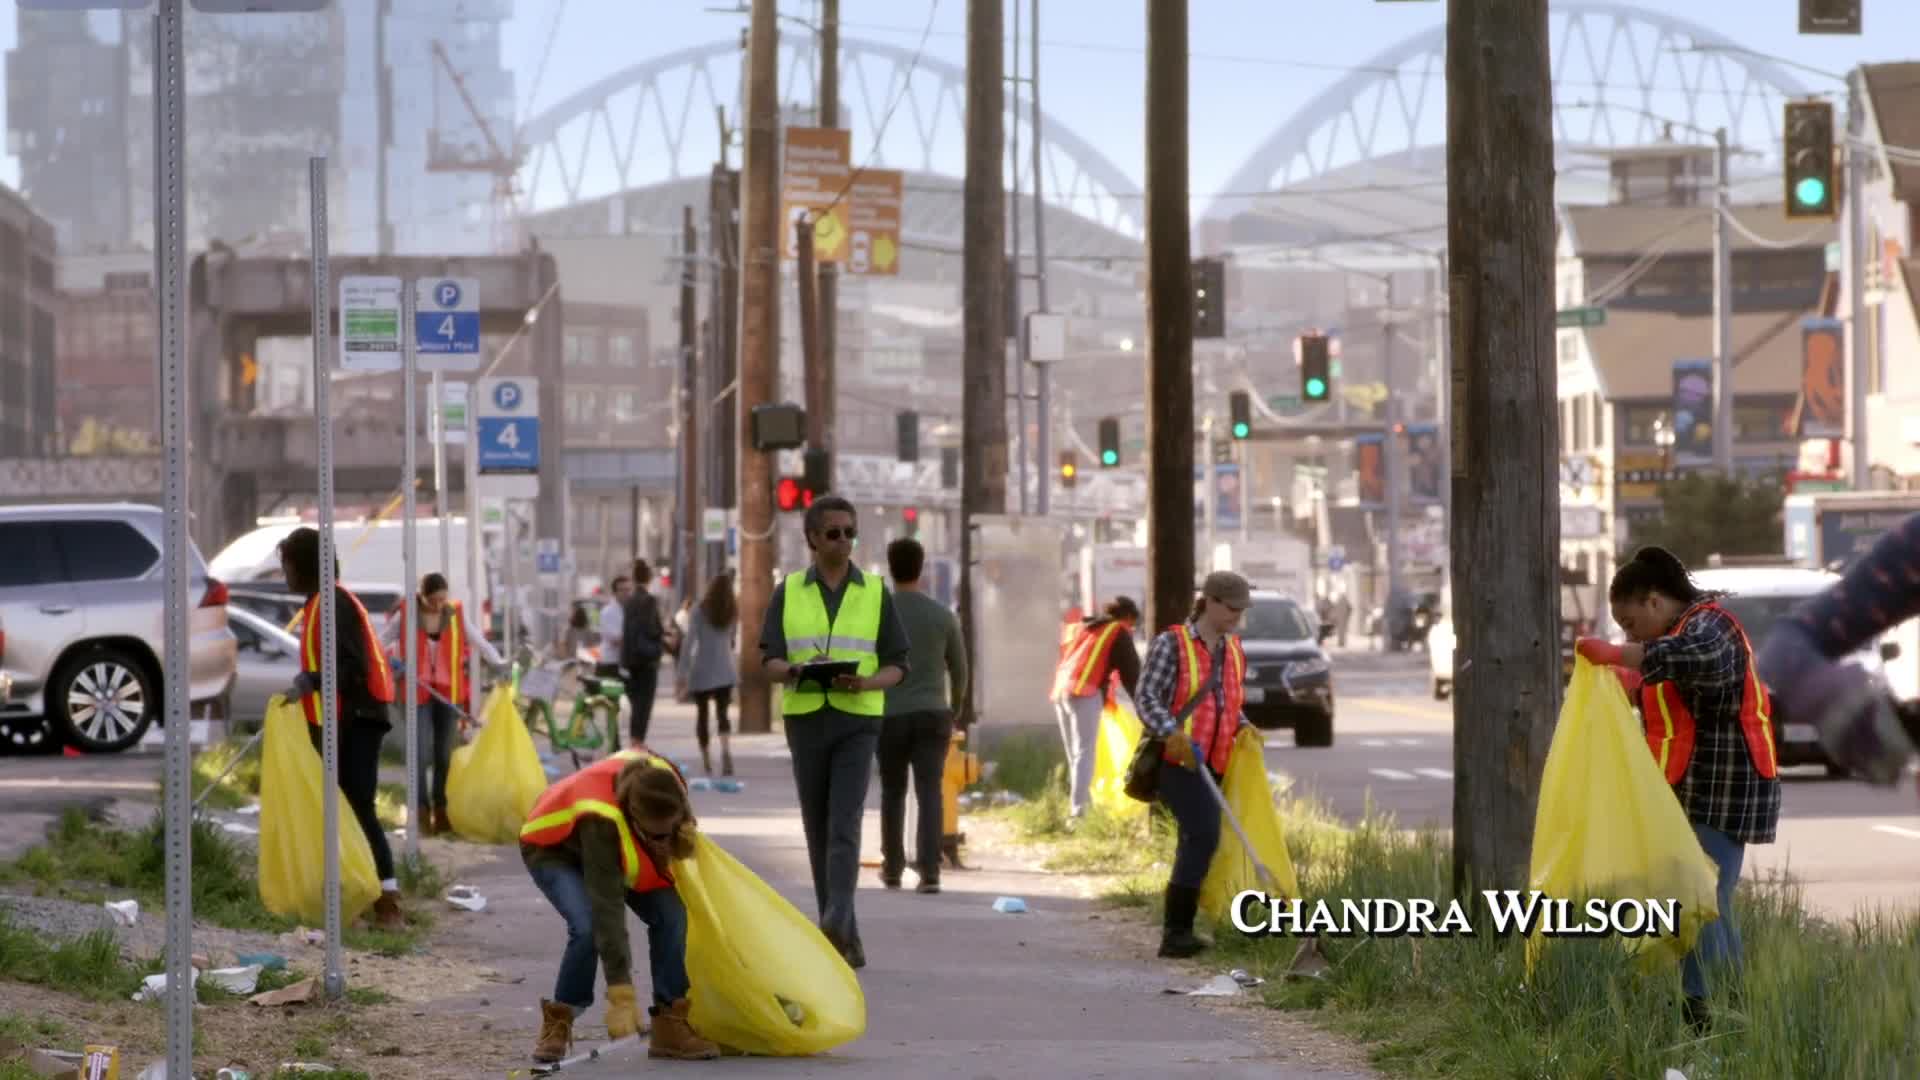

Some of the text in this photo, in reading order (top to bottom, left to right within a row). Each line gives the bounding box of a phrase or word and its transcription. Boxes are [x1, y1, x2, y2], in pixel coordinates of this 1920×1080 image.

[441, 285, 457, 305] P
[437, 314, 455, 341] 4
[501, 386, 517, 405] P
[496, 422, 519, 449] 4
